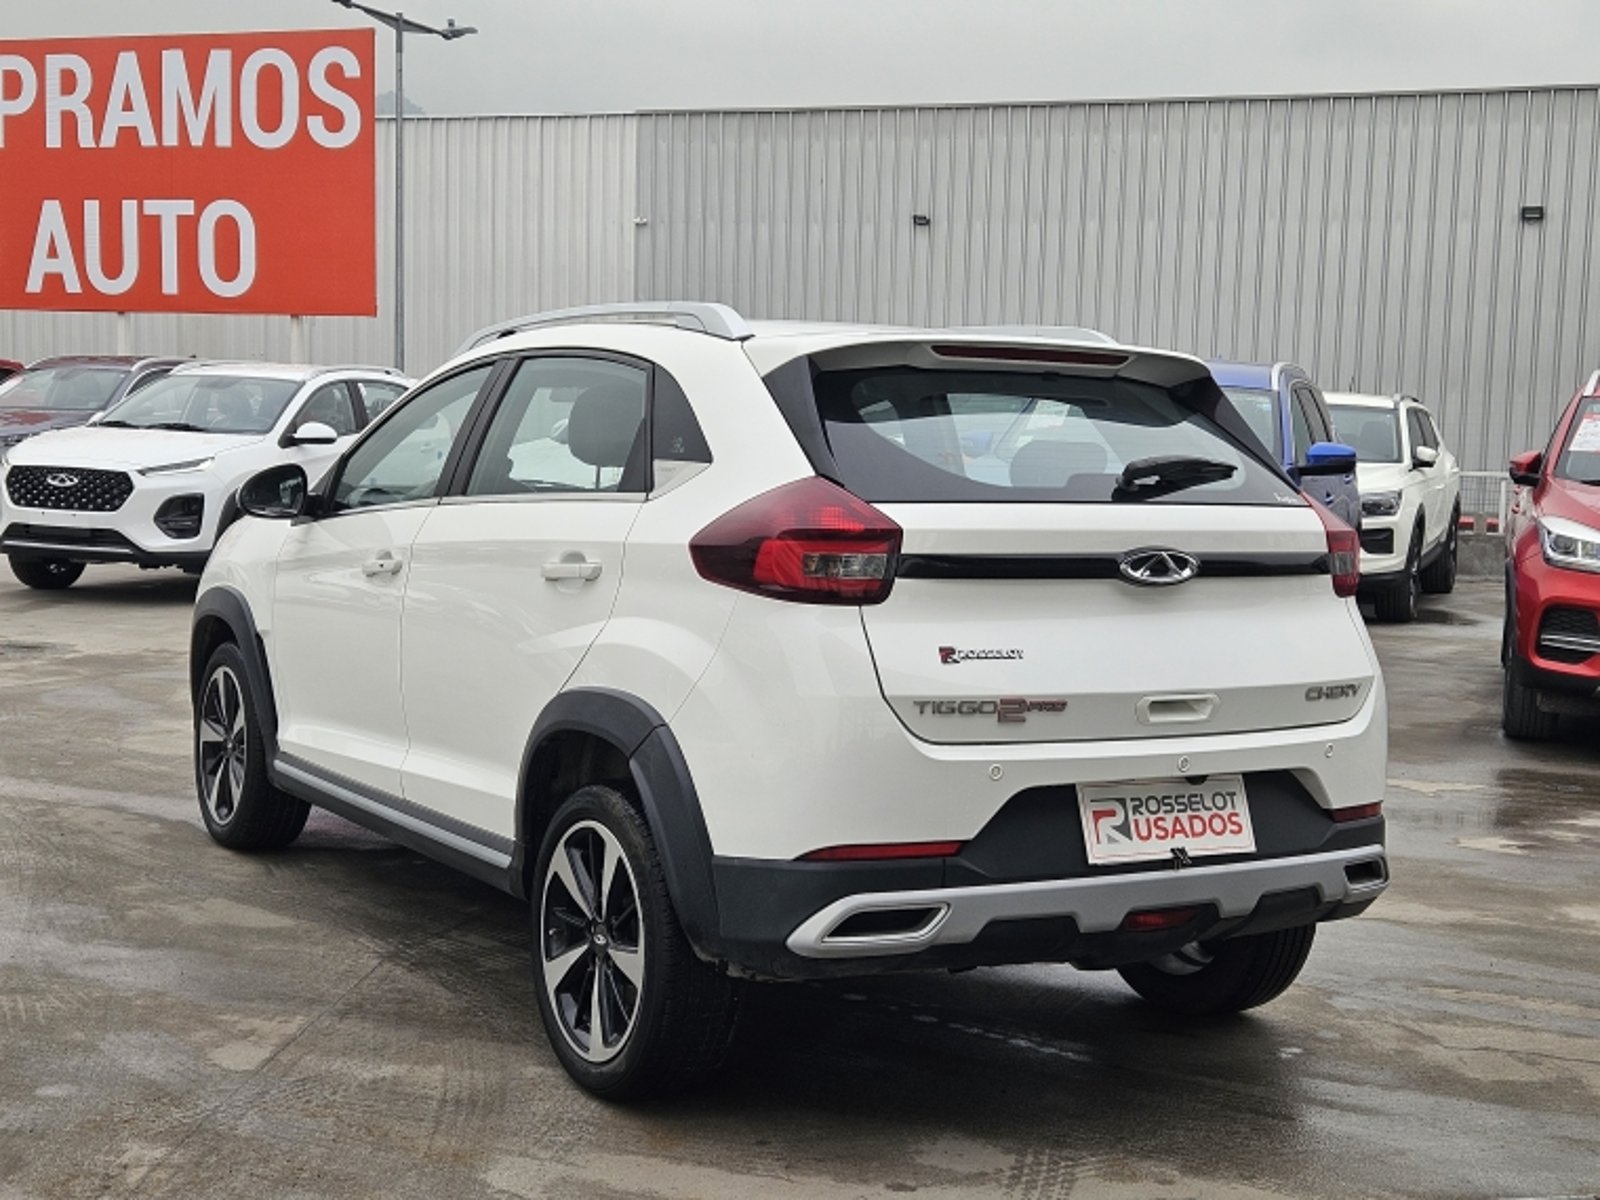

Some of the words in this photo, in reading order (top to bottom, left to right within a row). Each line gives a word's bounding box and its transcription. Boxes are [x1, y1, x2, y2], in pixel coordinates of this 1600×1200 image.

[0, 46, 361, 149] PRAMOS
[25, 199, 257, 297] AUTO
[1305, 683, 1362, 701] CHERY
[1130, 791, 1237, 816] ROSSELOT
[1134, 812, 1243, 842] USADOS
